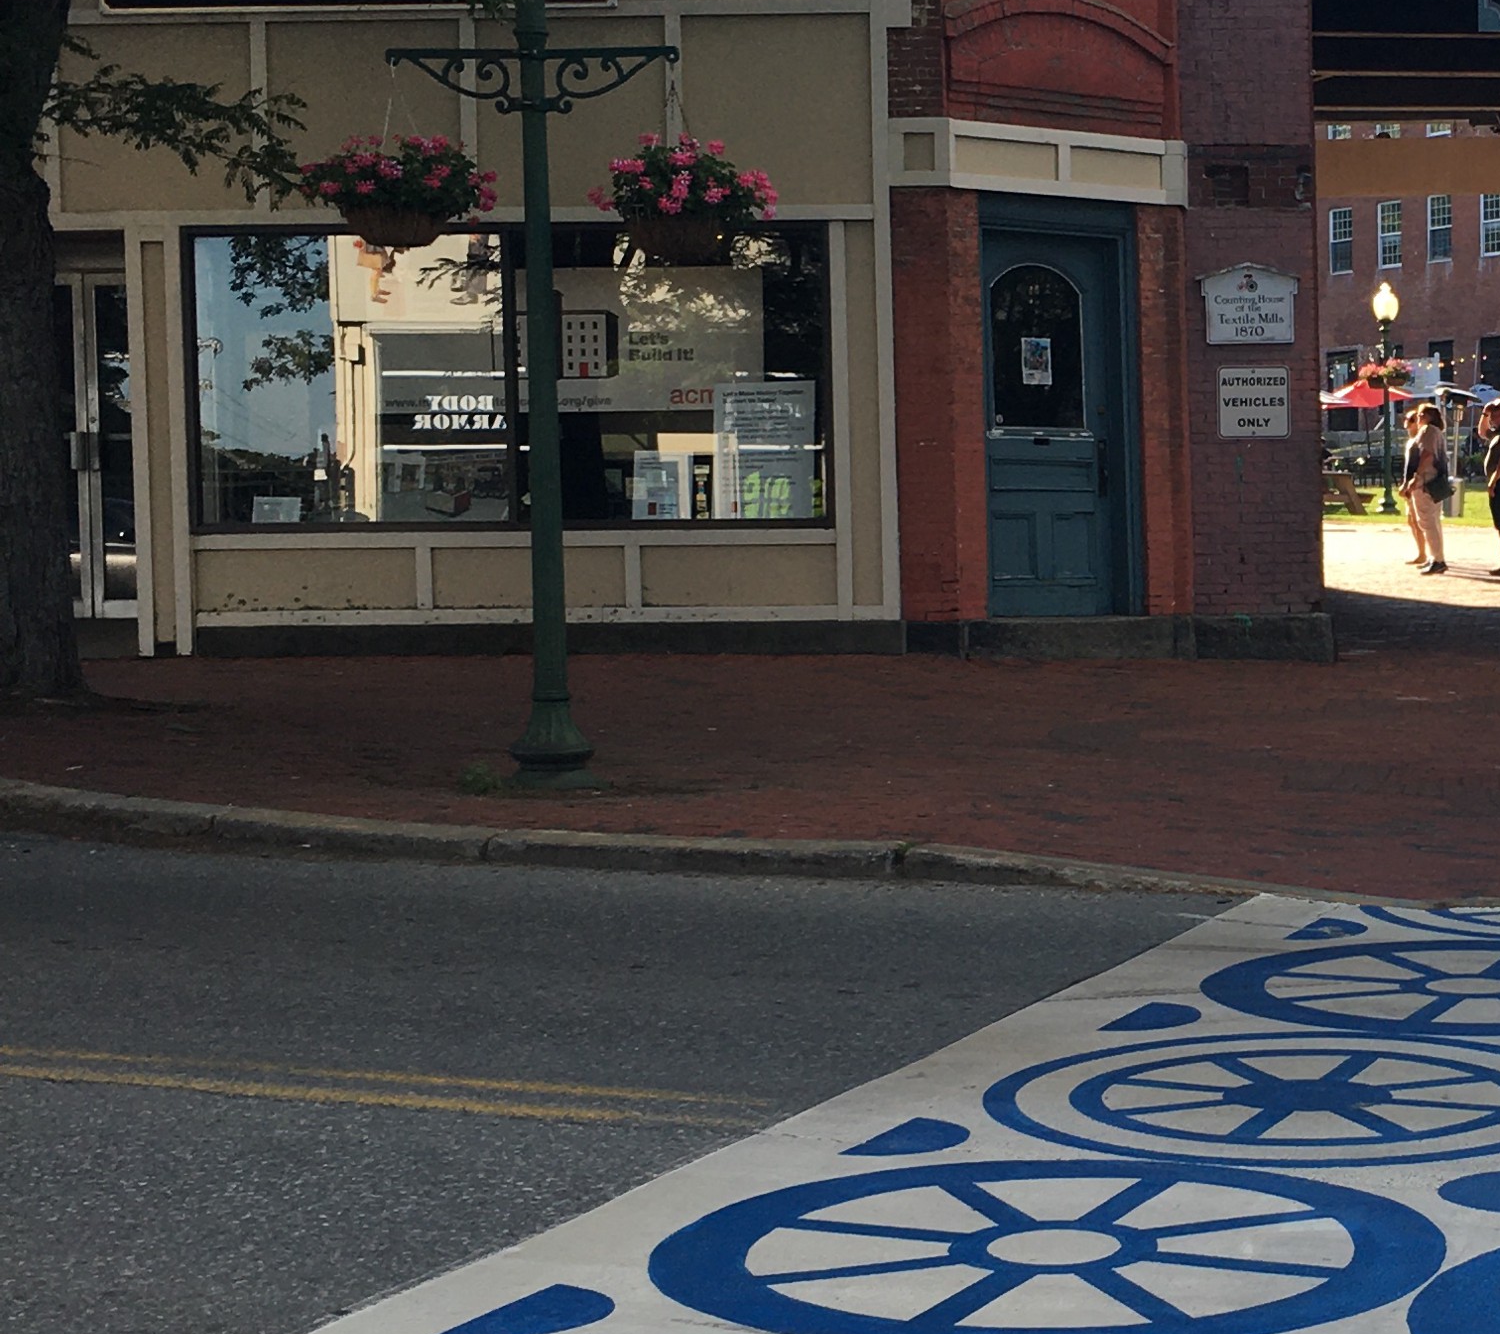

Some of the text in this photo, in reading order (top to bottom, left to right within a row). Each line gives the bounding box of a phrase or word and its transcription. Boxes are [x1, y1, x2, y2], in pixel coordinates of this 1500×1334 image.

[1214, 294, 1285, 306] Counting House
[1217, 313, 1285, 325] Textile Mills
[1234, 325, 1265, 338] 1870
[628, 331, 670, 346] Let's
[628, 348, 673, 361] Build
[1220, 376, 1286, 387] AUTHORIZED
[1222, 397, 1286, 407] VEHICLES
[1237, 417, 1271, 428] ONLY
